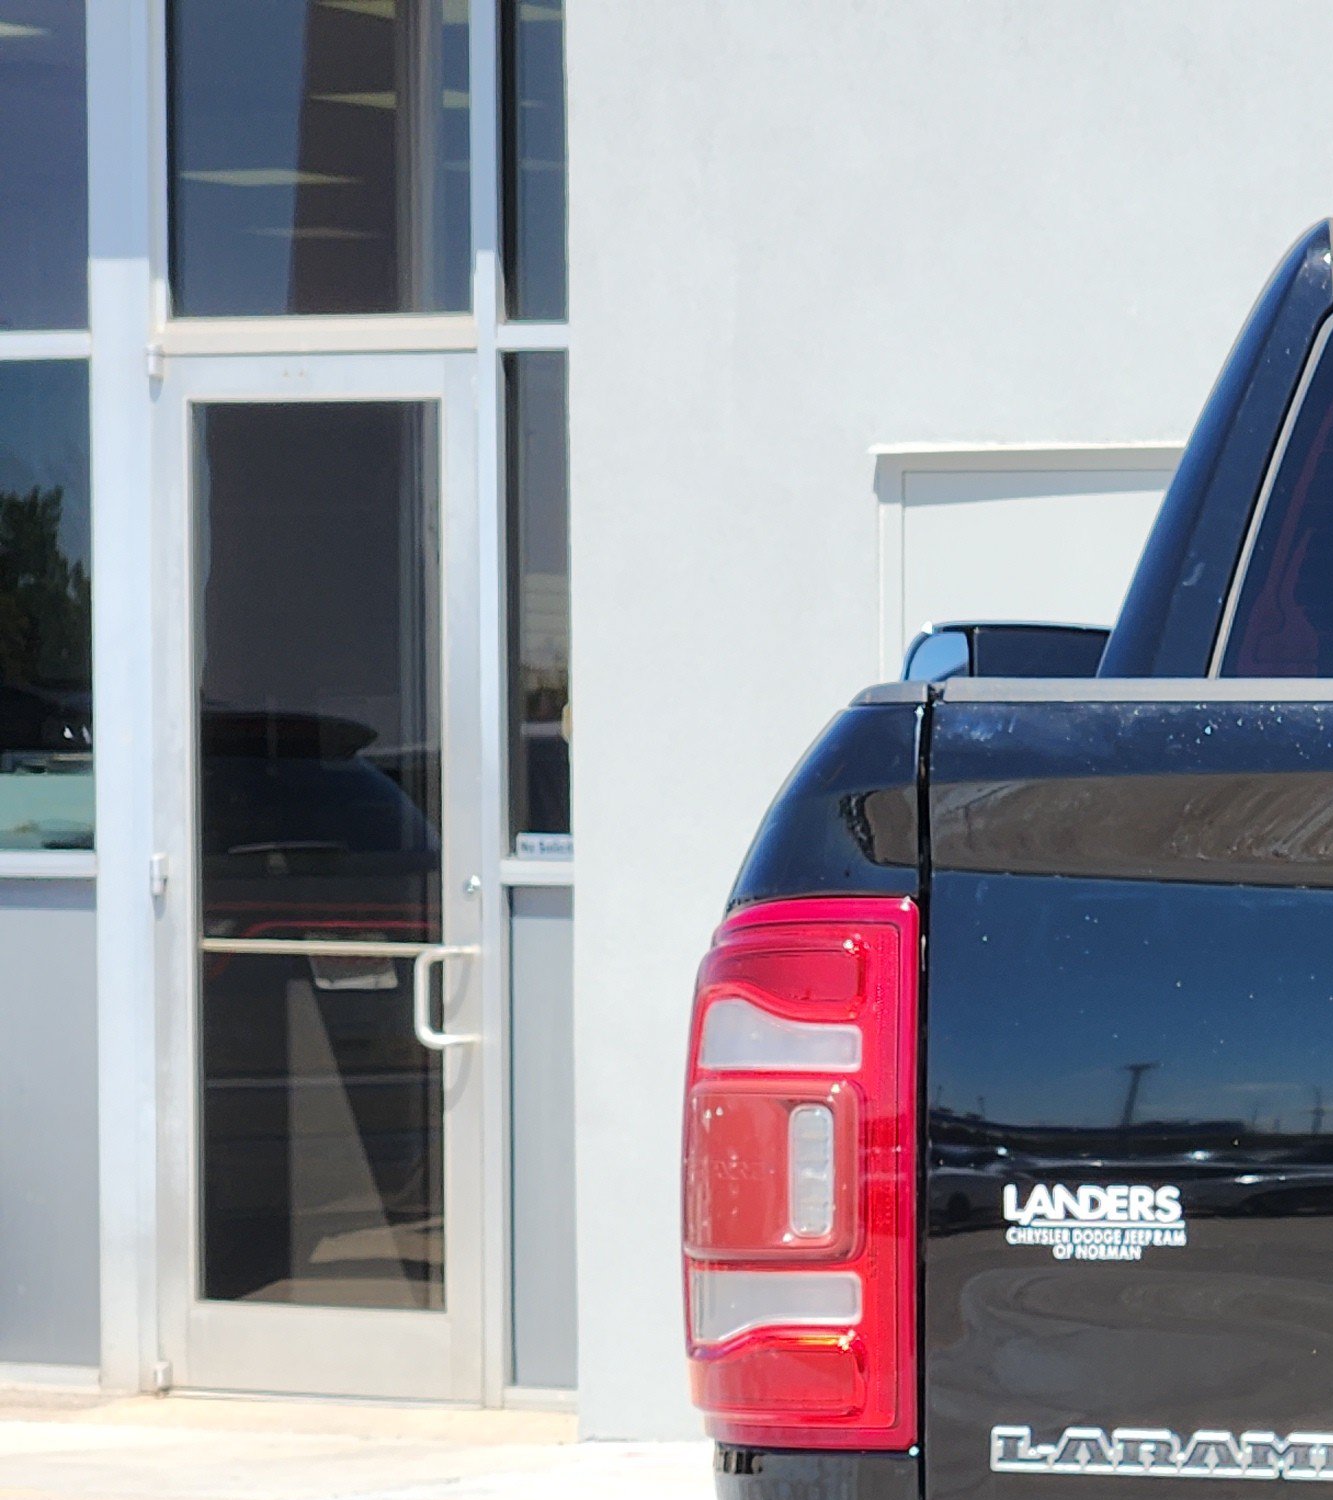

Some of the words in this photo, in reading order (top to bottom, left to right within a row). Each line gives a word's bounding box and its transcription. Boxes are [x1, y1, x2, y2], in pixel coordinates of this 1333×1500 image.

[1003, 1183, 1183, 1226] LANDERS
[1006, 1226, 1071, 1246] CHRYSLER
[1073, 1228, 1122, 1246] DODGE
[1123, 1229, 1153, 1246] JEEP
[1153, 1229, 1187, 1247] RAM
[1052, 1244, 1074, 1260] OF
[1075, 1244, 1142, 1261] NORMAN
